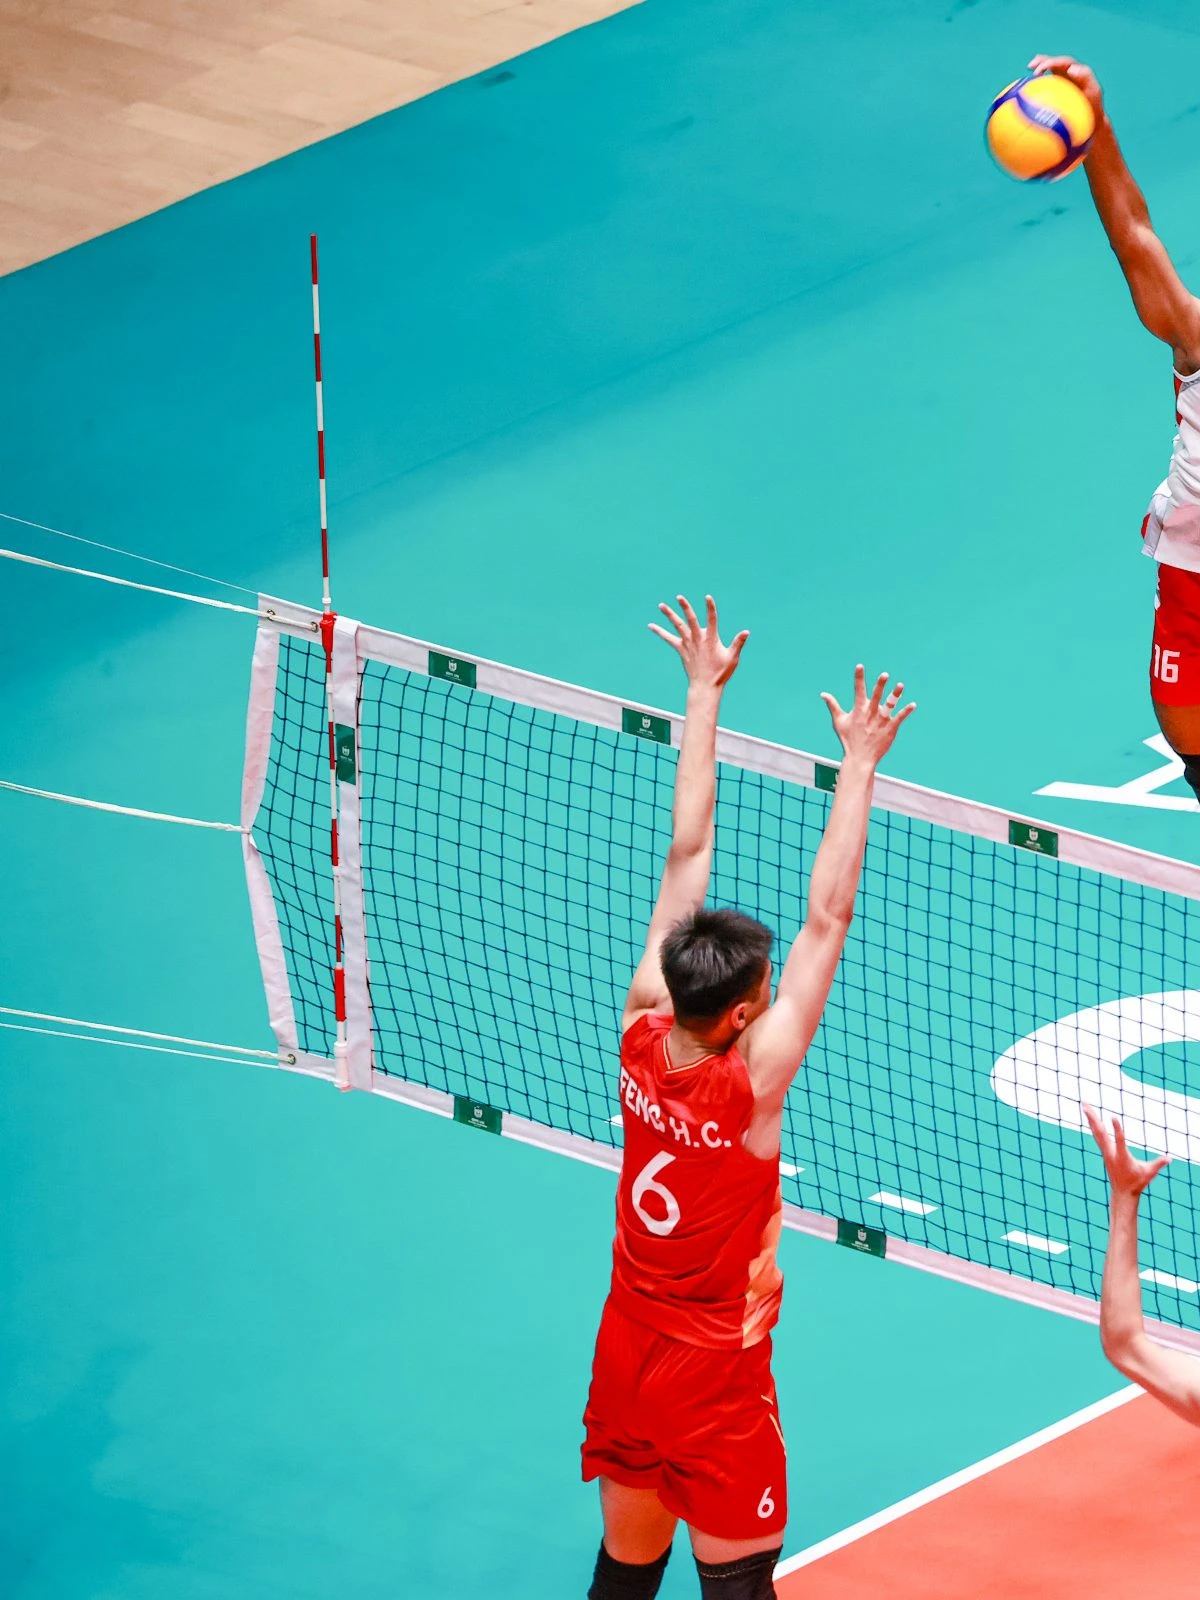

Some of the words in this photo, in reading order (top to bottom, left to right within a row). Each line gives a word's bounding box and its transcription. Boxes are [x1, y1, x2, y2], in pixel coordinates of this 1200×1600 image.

[1153, 644, 1181, 684] 16
[631, 1150, 681, 1237] 6
[757, 1485, 775, 1519] 6
